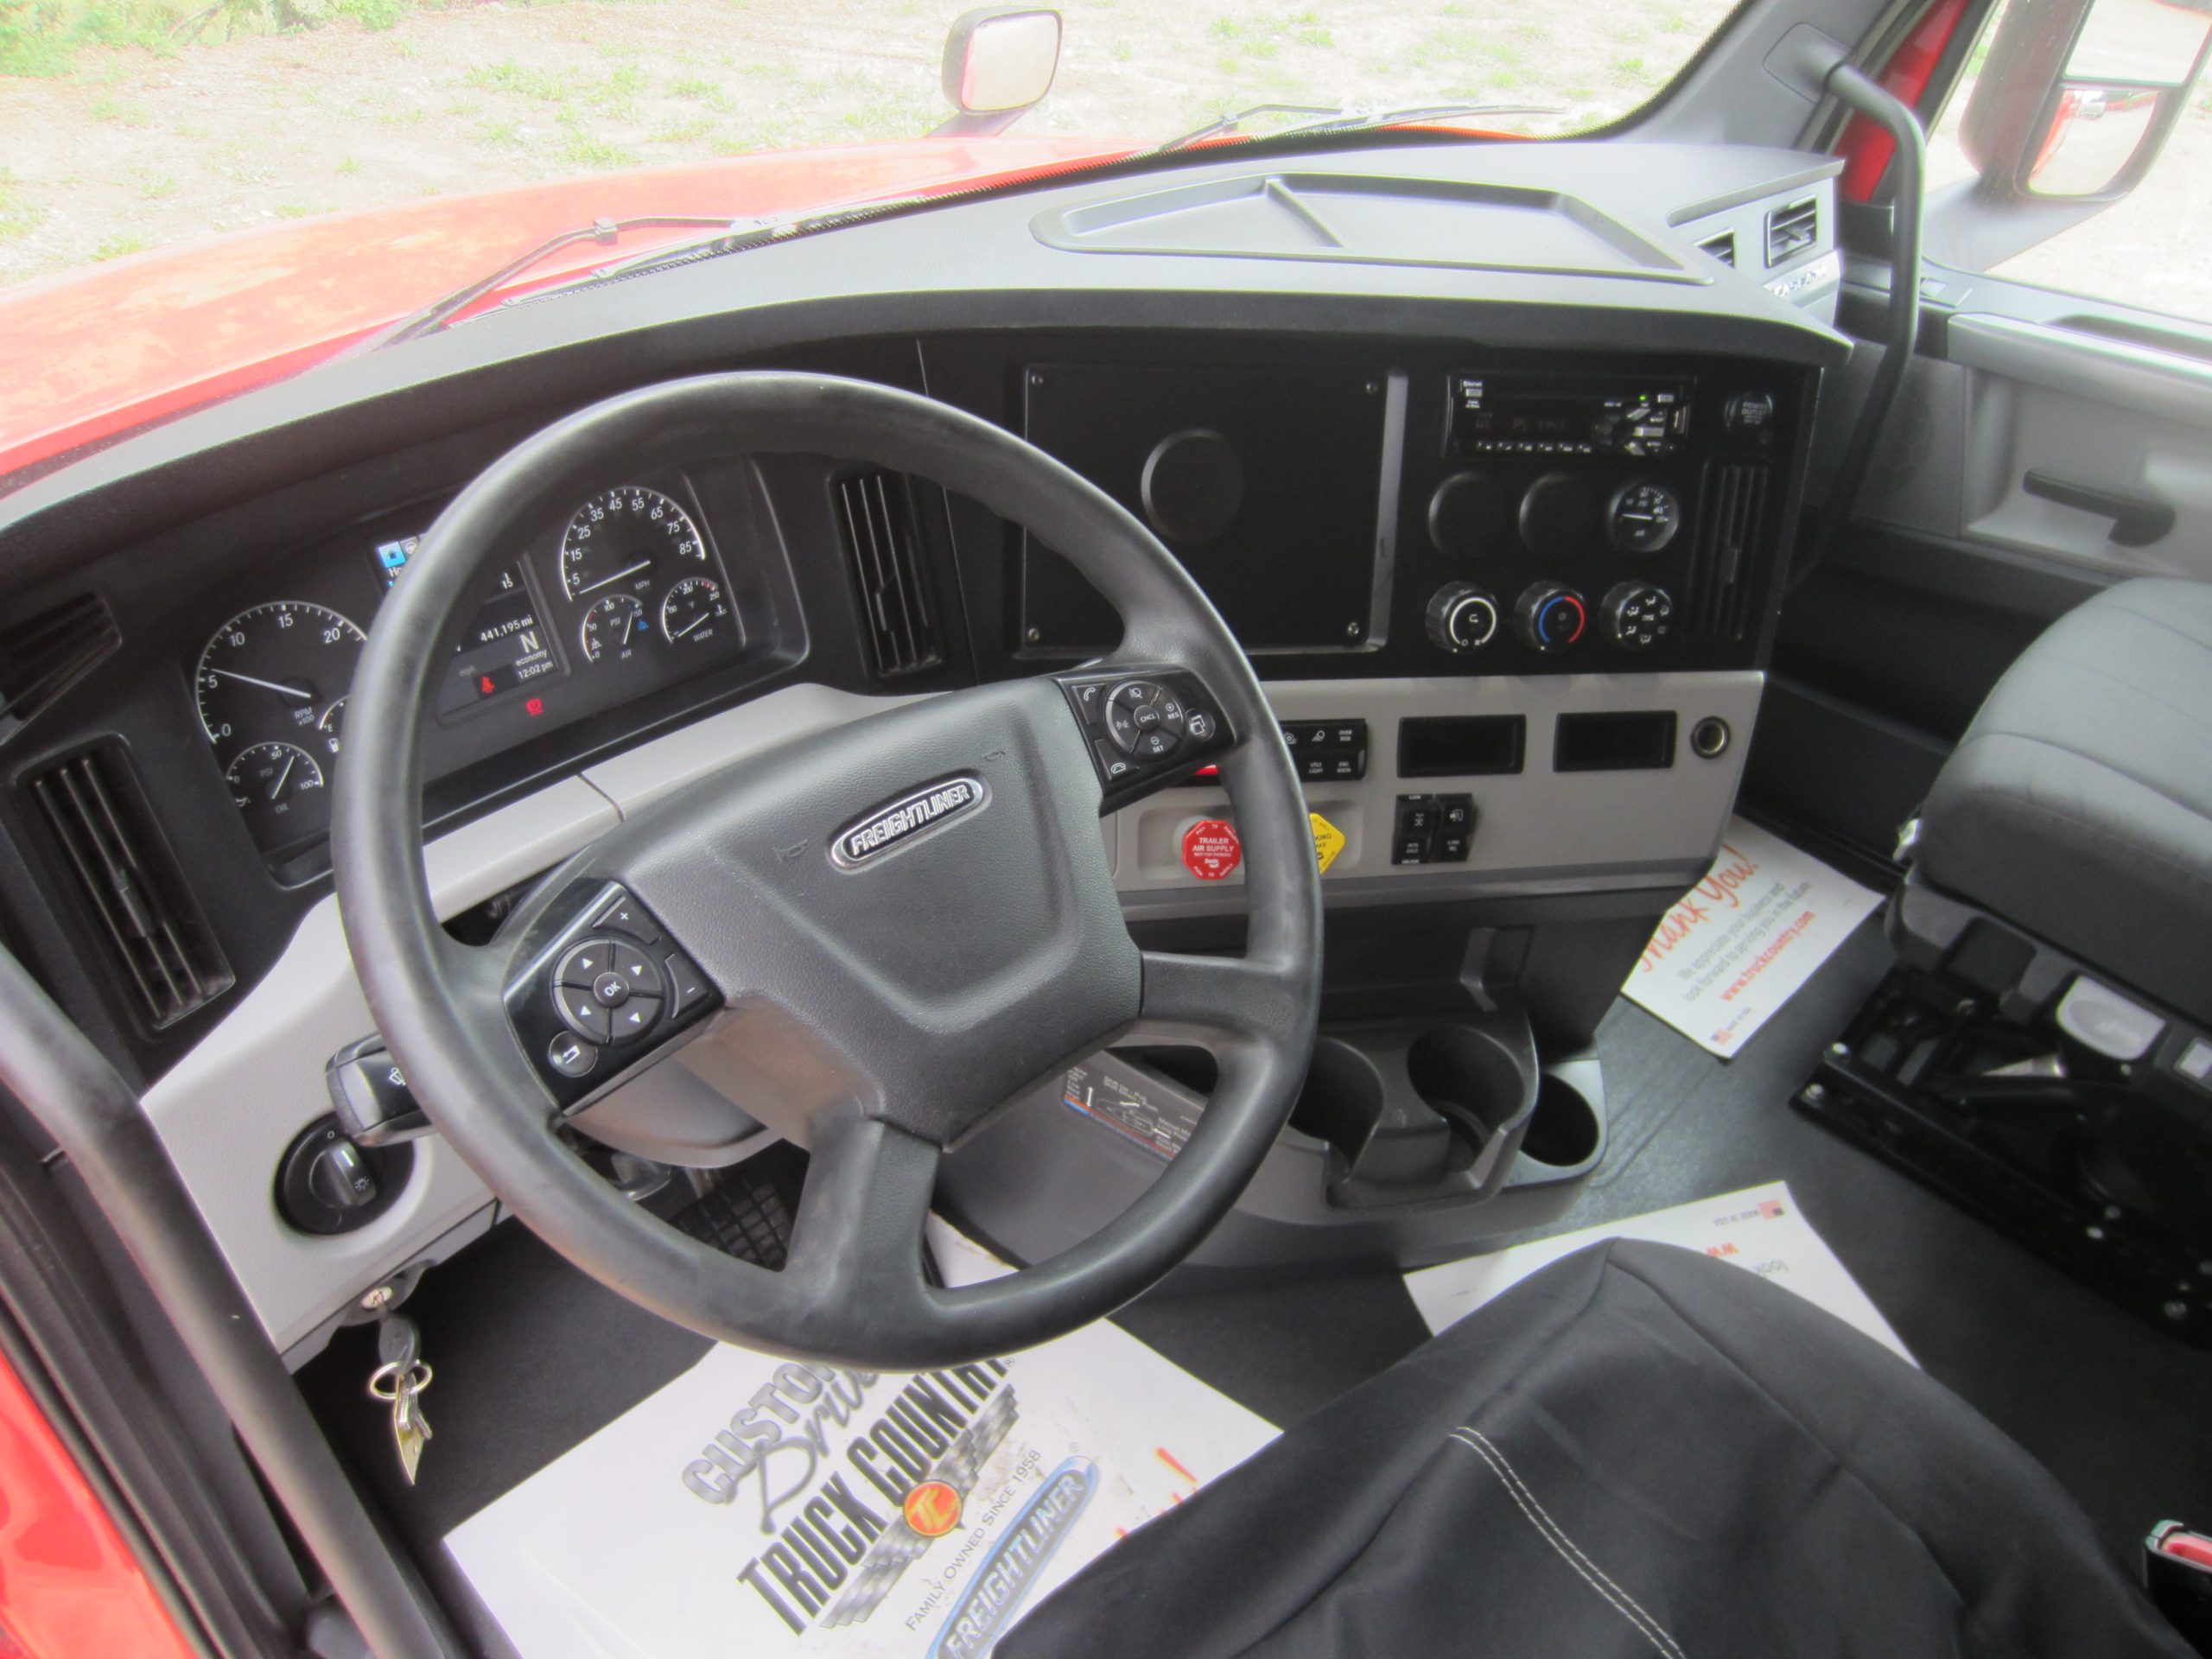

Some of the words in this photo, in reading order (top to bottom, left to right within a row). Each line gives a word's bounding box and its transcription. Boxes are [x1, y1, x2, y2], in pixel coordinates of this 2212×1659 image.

[609, 498, 622, 511] 45
[632, 497, 645, 511] 55
[590, 508, 604, 521] 35
[651, 506, 664, 520] 65
[578, 525, 591, 539] 25
[667, 521, 680, 535] 75
[570, 548, 582, 561] 15
[679, 541, 692, 555] 85
[573, 574, 580, 585] 5
[635, 580, 650, 590] MPH
[709, 592, 720, 601] 250
[278, 613, 293, 628] 15
[610, 618, 620, 626] PSI
[480, 620, 520, 642] 441,195
[521, 614, 533, 627] mi
[230, 632, 245, 647] 10
[323, 627, 340, 644] 20
[520, 631, 539, 653] N
[693, 629, 714, 642] WATER
[516, 649, 548, 666] economy
[621, 650, 632, 659] AIR
[518, 664, 542, 679] 12:02
[542, 660, 553, 672] pm
[208, 676, 218, 688] 5
[294, 707, 313, 720] RPM
[1140, 714, 1156, 722] CNCL
[221, 724, 232, 736] 0
[270, 750, 282, 760] 50
[300, 779, 314, 790] 100
[276, 804, 289, 813] OIL
[851, 785, 970, 855] FREIGHTLINER
[1695, 842, 1759, 908] You!
[1719, 909, 1816, 1001] www.truckcountry.com
[605, 981, 621, 996] OK
[905, 1584, 947, 1631] FAMILY
[944, 1526, 986, 1580] OWNED
[984, 1484, 1018, 1527] SINCE
[1012, 1449, 1041, 1485] 1958
[736, 1471, 888, 1637] TRUCK
[945, 1473, 1084, 1659] FREIGHTLINER
